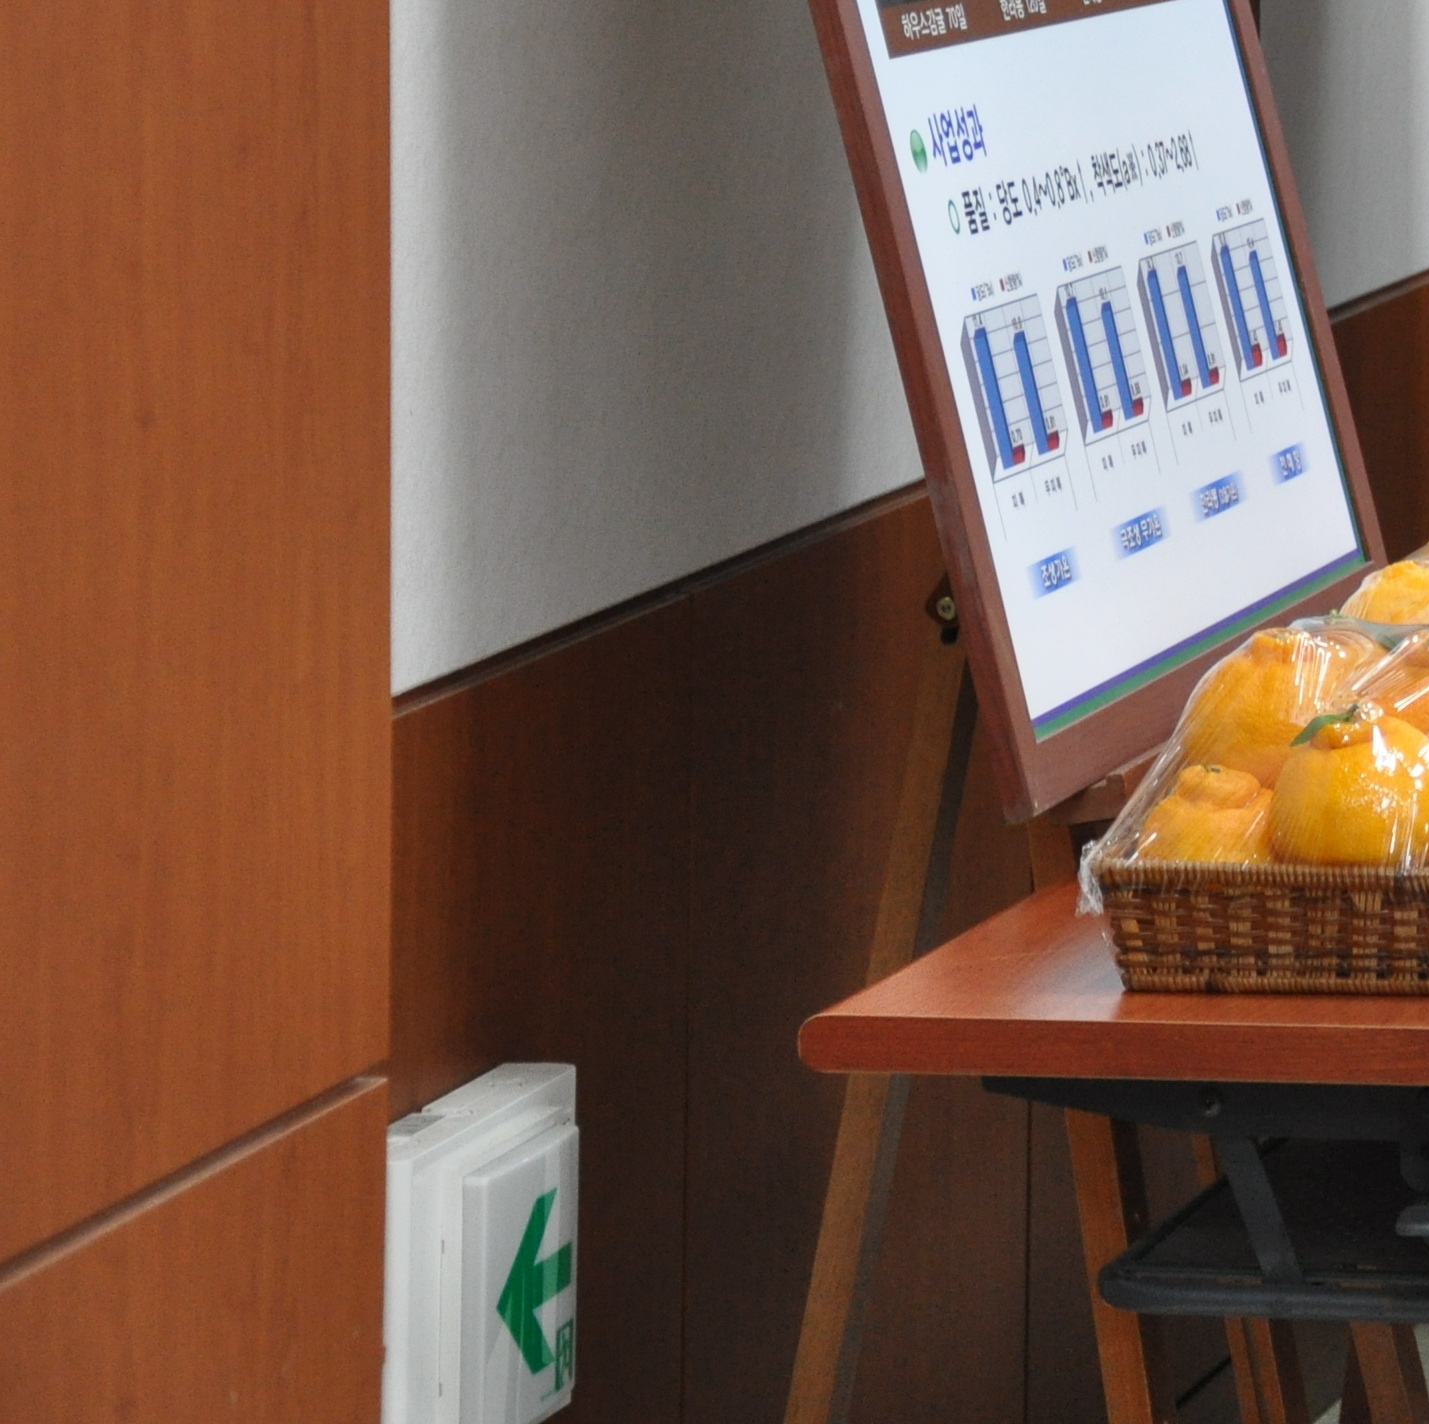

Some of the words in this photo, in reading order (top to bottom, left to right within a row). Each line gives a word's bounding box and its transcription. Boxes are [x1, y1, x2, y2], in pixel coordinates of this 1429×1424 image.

[900, 6, 947, 41] 하우스감귤
[944, 3, 968, 32] 70일
[923, 104, 989, 168] 사업성과
[959, 187, 991, 234] 품질
[994, 178, 1024, 225] 당도
[1039, 554, 1072, 592] 조생가온
